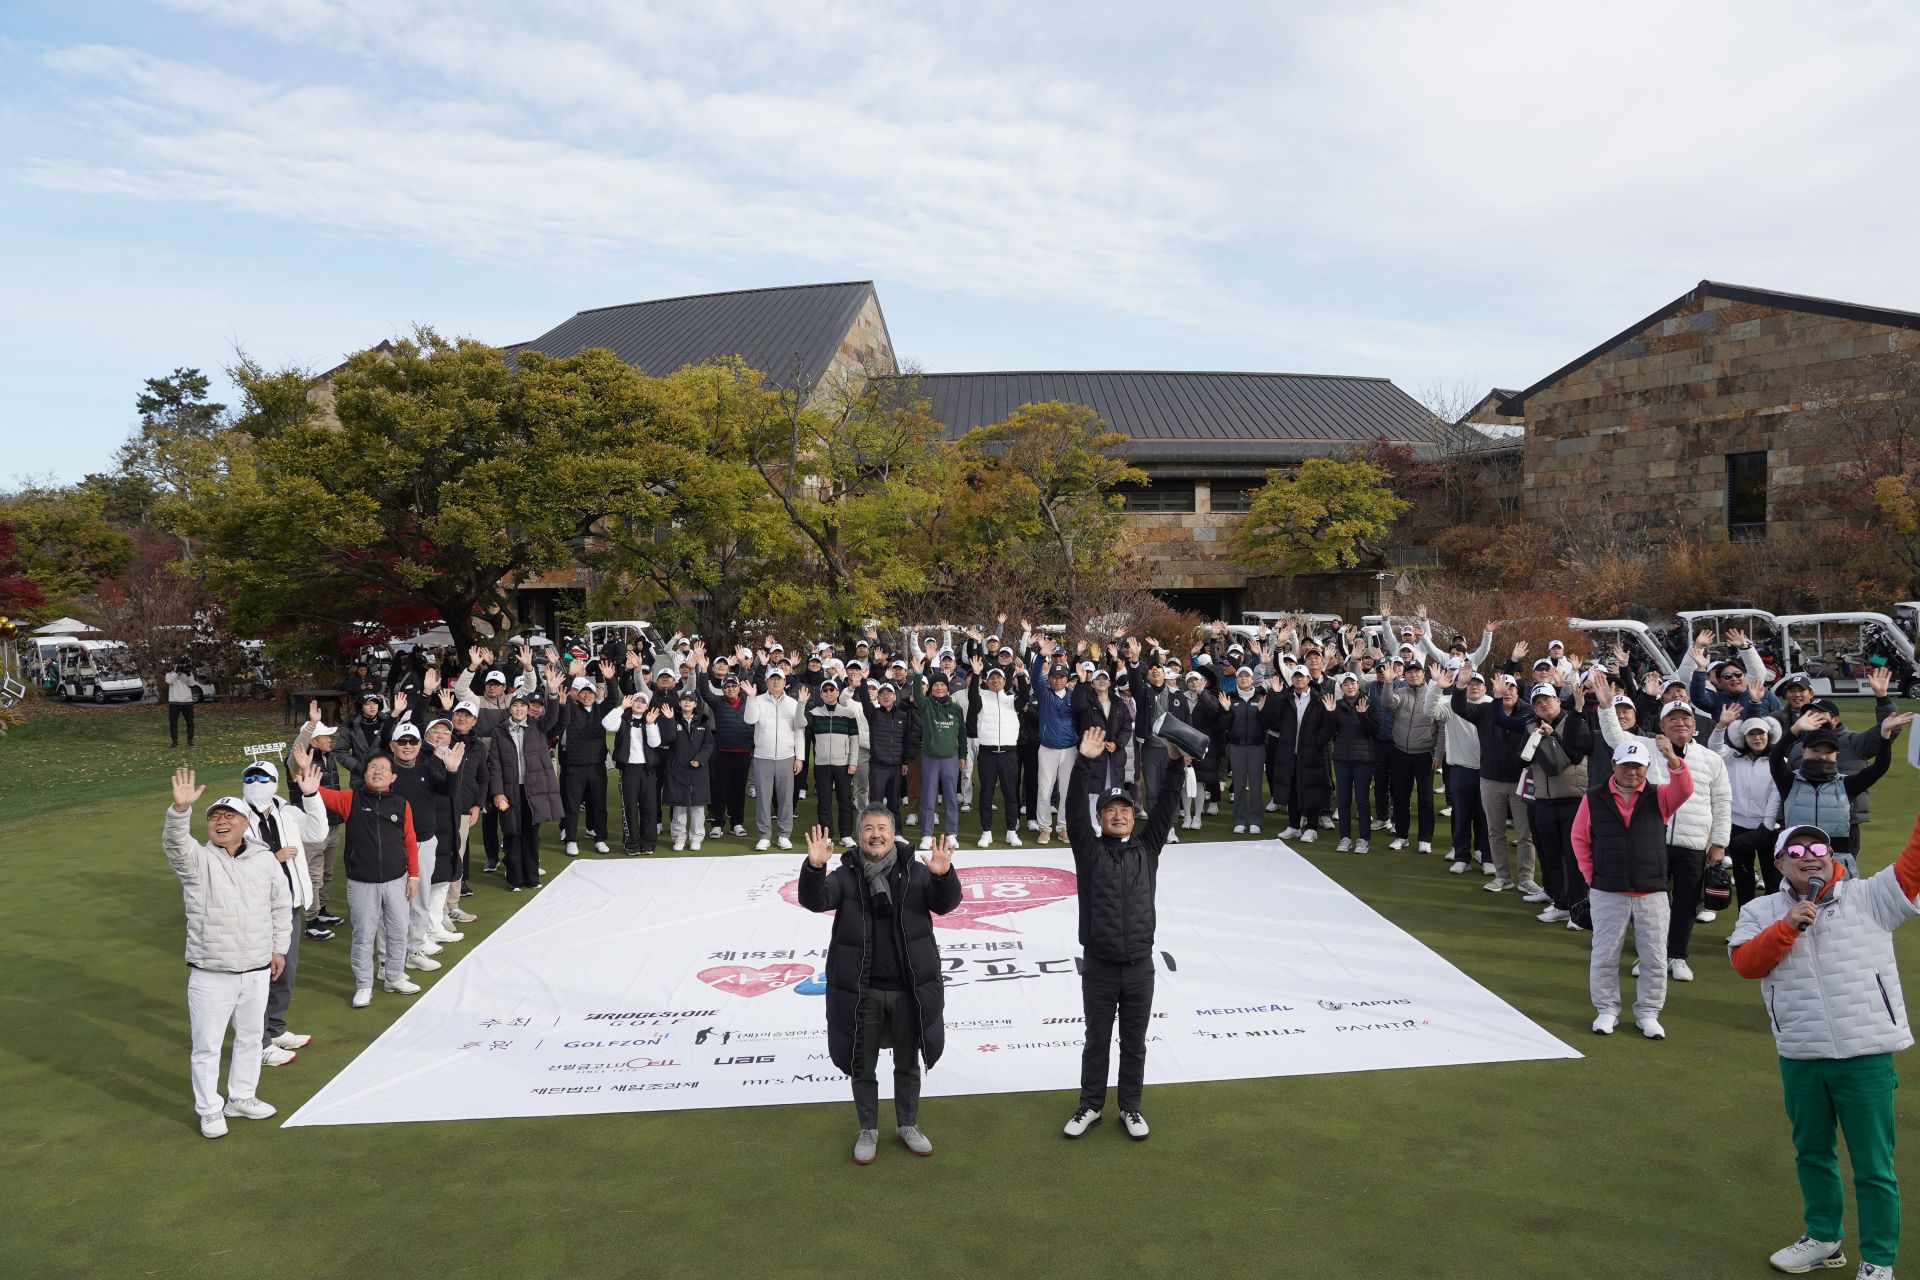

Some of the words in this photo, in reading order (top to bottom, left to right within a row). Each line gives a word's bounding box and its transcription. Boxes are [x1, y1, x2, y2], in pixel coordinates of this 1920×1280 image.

[963, 881, 1031, 899] 18
[707, 950, 795, 961] 제18회
[937, 941, 1024, 952] 프대회
[584, 1009, 720, 1021] BRIDGESTONE
[1196, 1004, 1295, 1016] MEDIHEAL
[609, 1019, 685, 1027] GOLF
[1335, 1019, 1417, 1033] PAYNTR
[1245, 1028, 1307, 1038] MILLS
[563, 1039, 662, 1049] GOLFZON
[1007, 1039, 1086, 1050] SHINSEG
[531, 1085, 602, 1095] 재단법인
